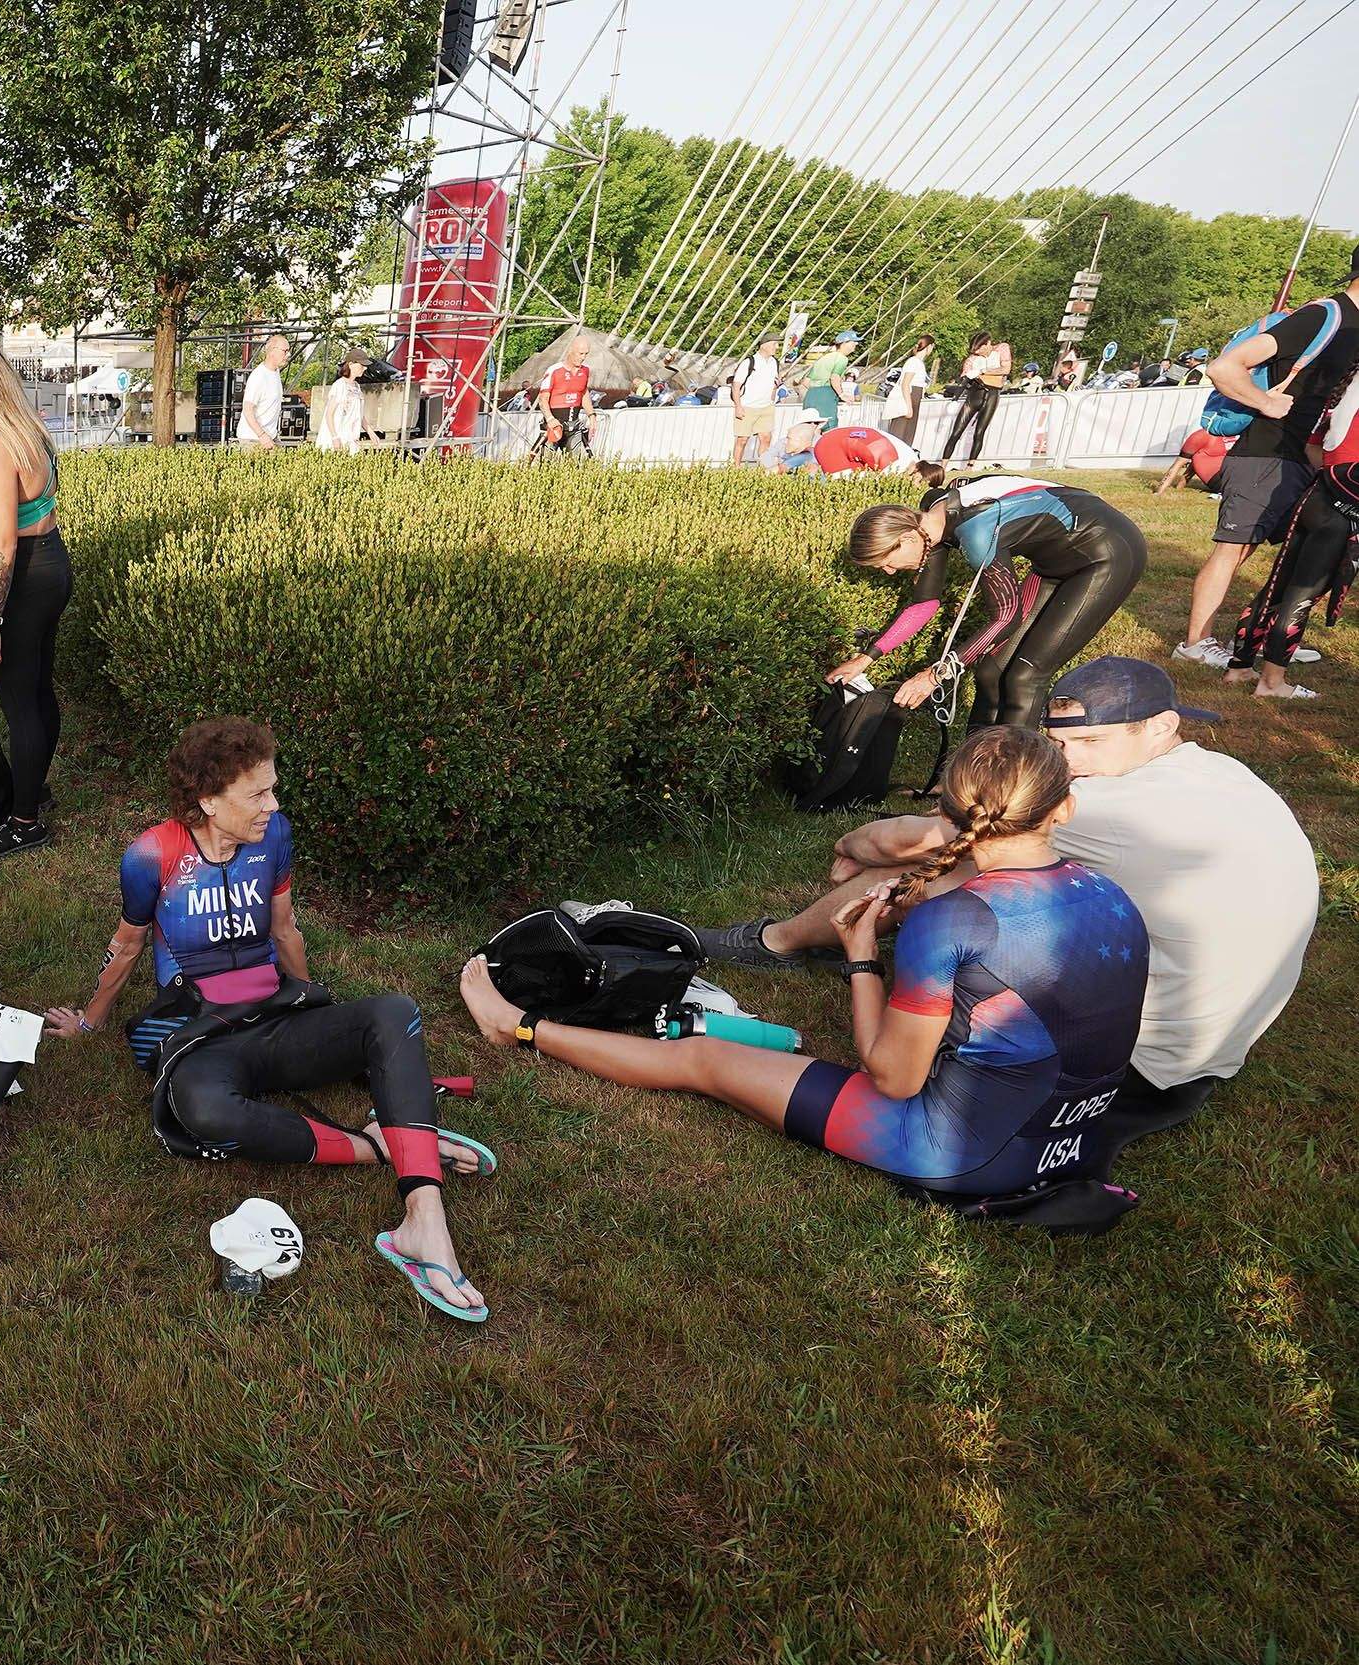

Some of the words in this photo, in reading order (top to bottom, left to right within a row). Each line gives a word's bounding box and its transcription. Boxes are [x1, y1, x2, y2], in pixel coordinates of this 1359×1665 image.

[187, 878, 264, 916] MINK
[207, 913, 258, 943] USA
[1049, 1087, 1119, 1128] LOPEZ
[1036, 1133, 1083, 1174] USA
